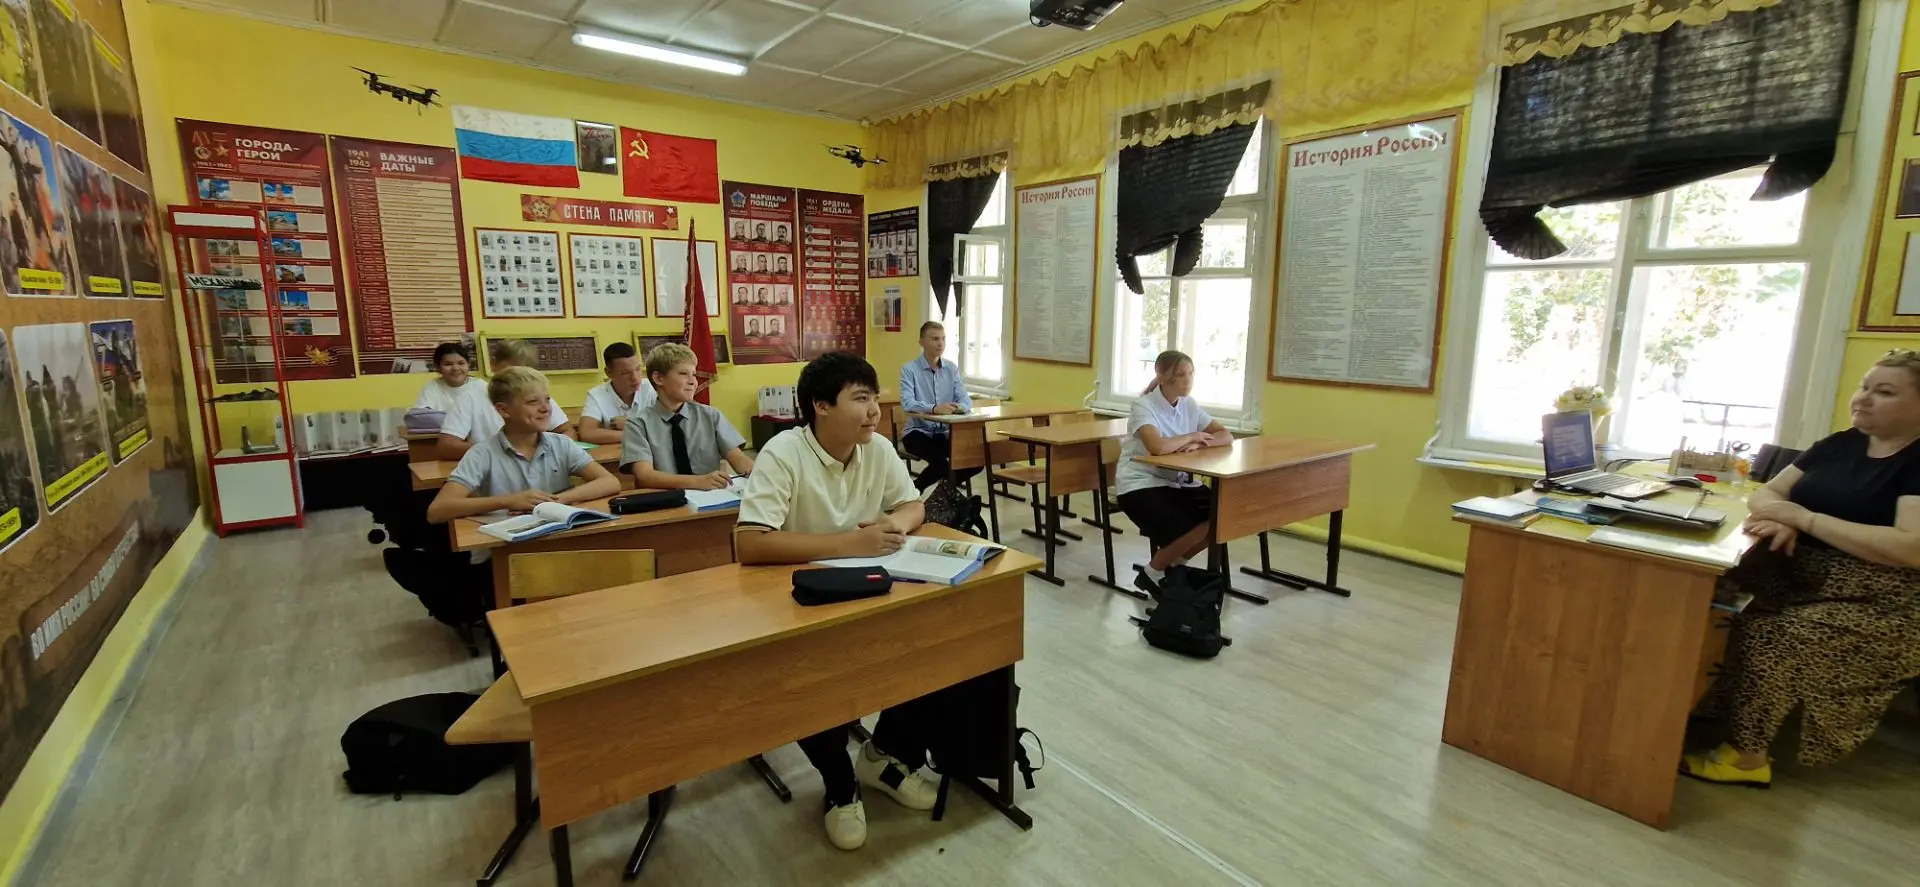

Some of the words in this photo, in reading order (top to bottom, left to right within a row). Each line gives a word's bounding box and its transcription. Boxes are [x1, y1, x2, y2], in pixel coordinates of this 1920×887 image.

[235, 138, 300, 152] ГОРОДА-
[236, 149, 281, 161] ГЕРОИ
[380, 152, 435, 166] ВАЖНЫЕ
[1293, 143, 1374, 168] История
[381, 162, 416, 173] ДАТЫ
[750, 193, 788, 203] МАРШАЛЫ
[822, 199, 850, 208] ОРДЕНА
[1022, 190, 1060, 205] История
[750, 199, 780, 209] ПОБЕДЫ
[563, 204, 601, 220] СТЕНА
[609, 207, 656, 224] ПАМЯТИ
[822, 206, 853, 215] МЕДАЛИ
